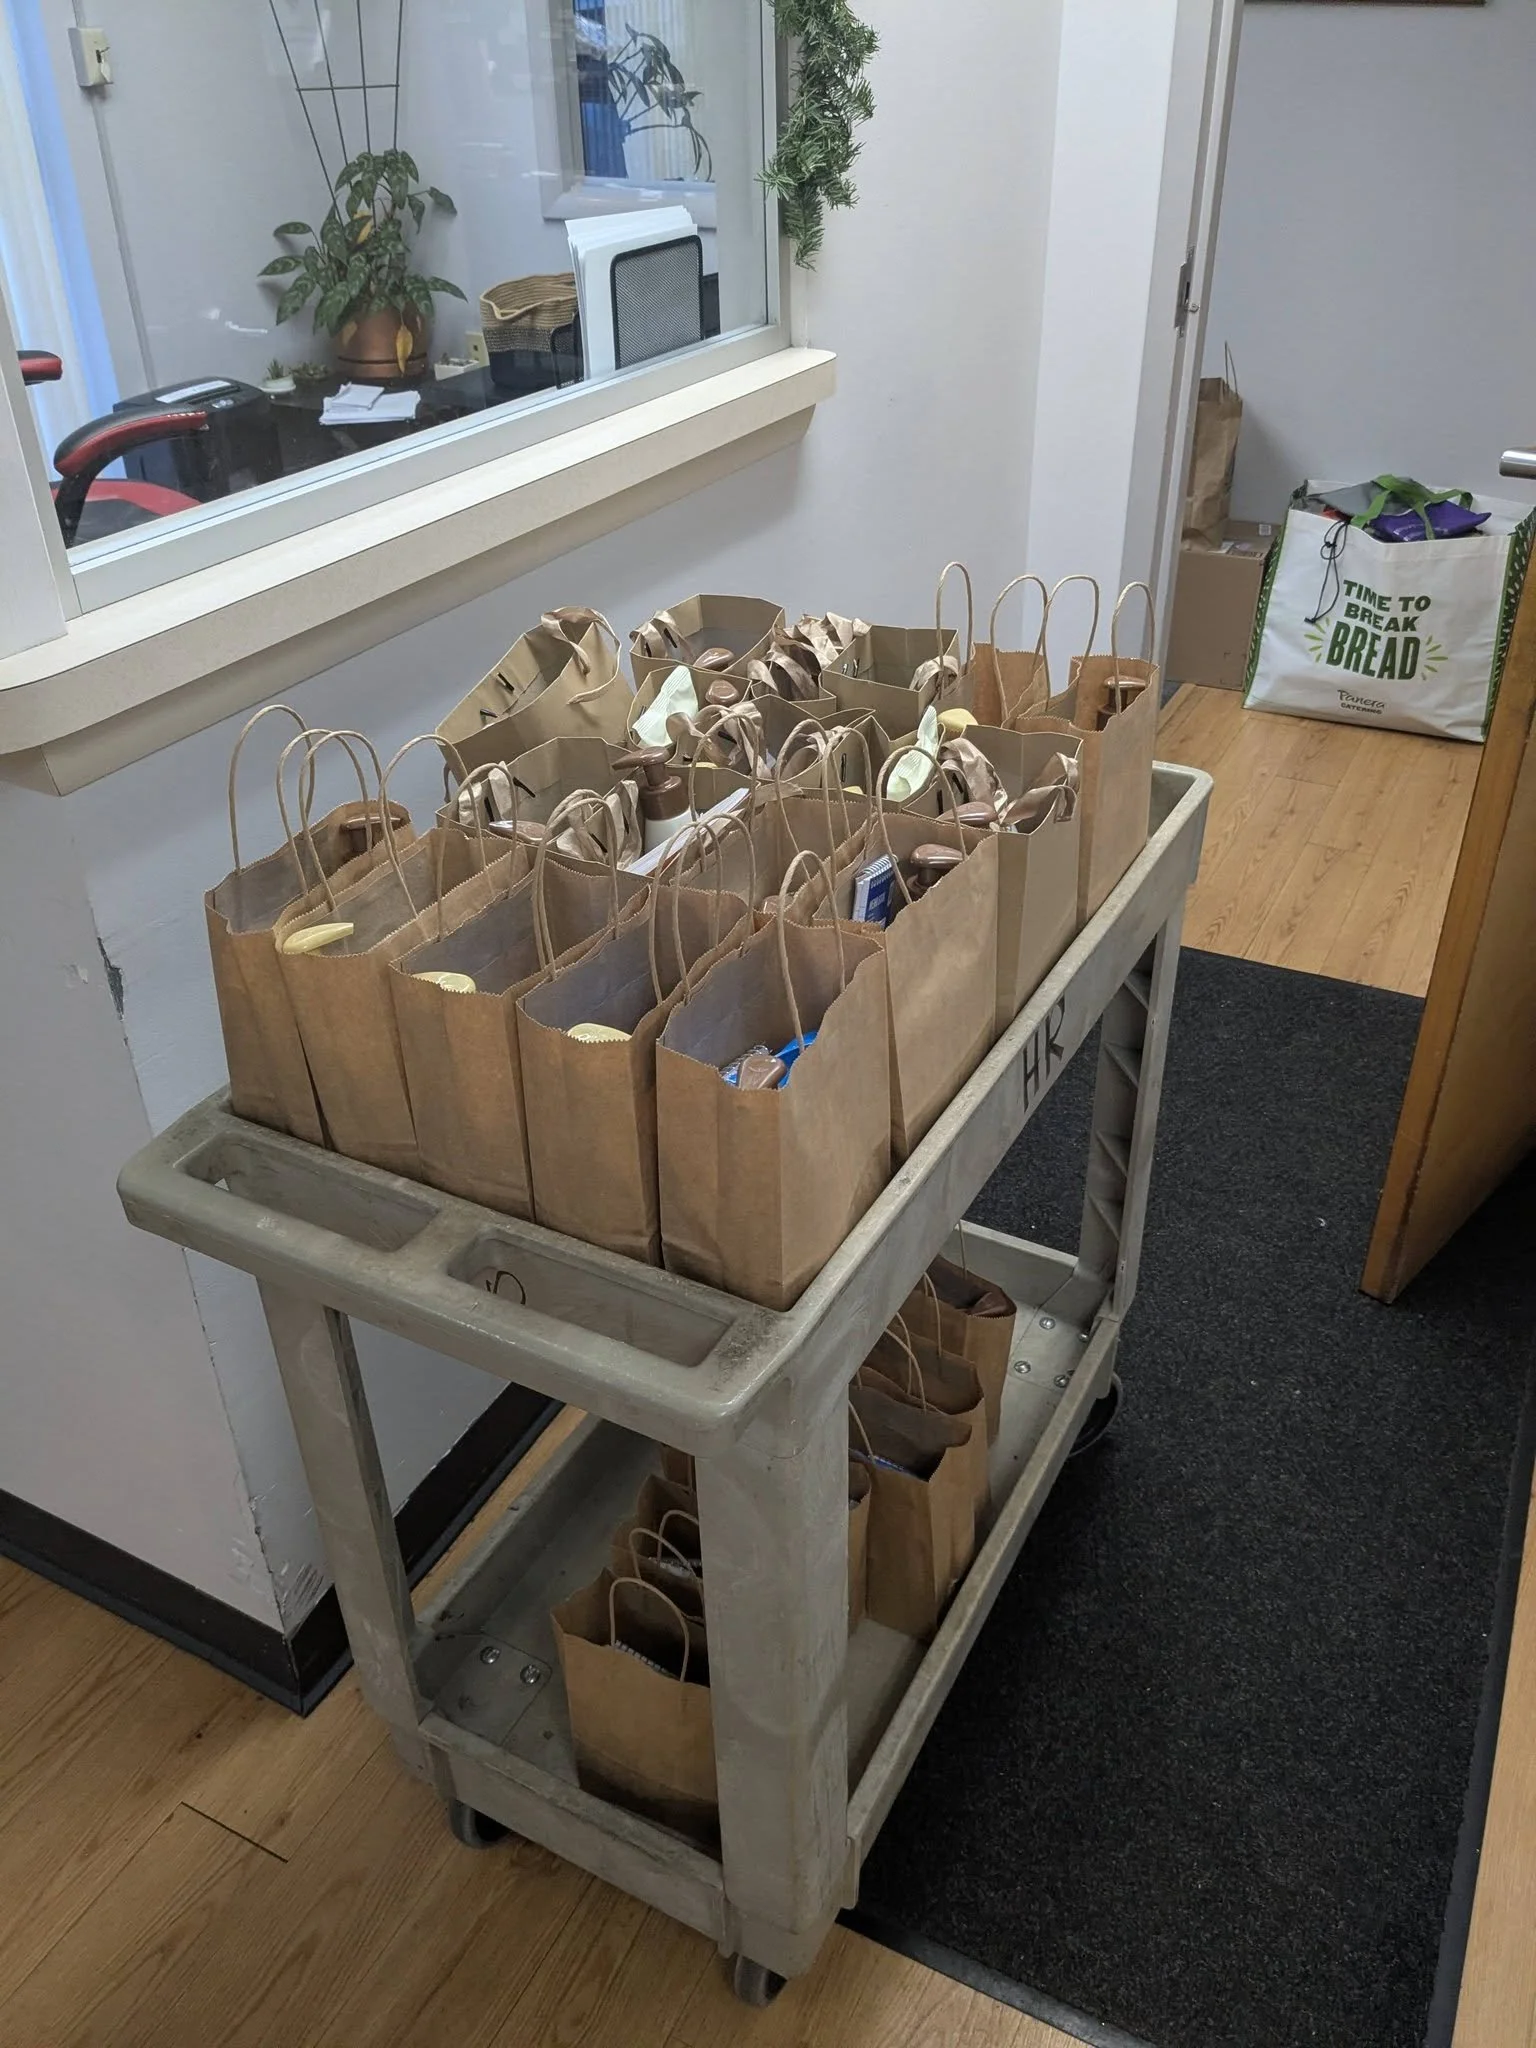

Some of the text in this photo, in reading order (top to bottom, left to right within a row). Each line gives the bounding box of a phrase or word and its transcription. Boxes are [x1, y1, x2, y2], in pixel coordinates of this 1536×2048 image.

[1343, 579, 1431, 612] TIME TO
[1344, 602, 1419, 632] BREAK
[1326, 620, 1420, 680] BREAD
[1337, 689, 1385, 708] Panera
[1023, 993, 1064, 1113] HR
